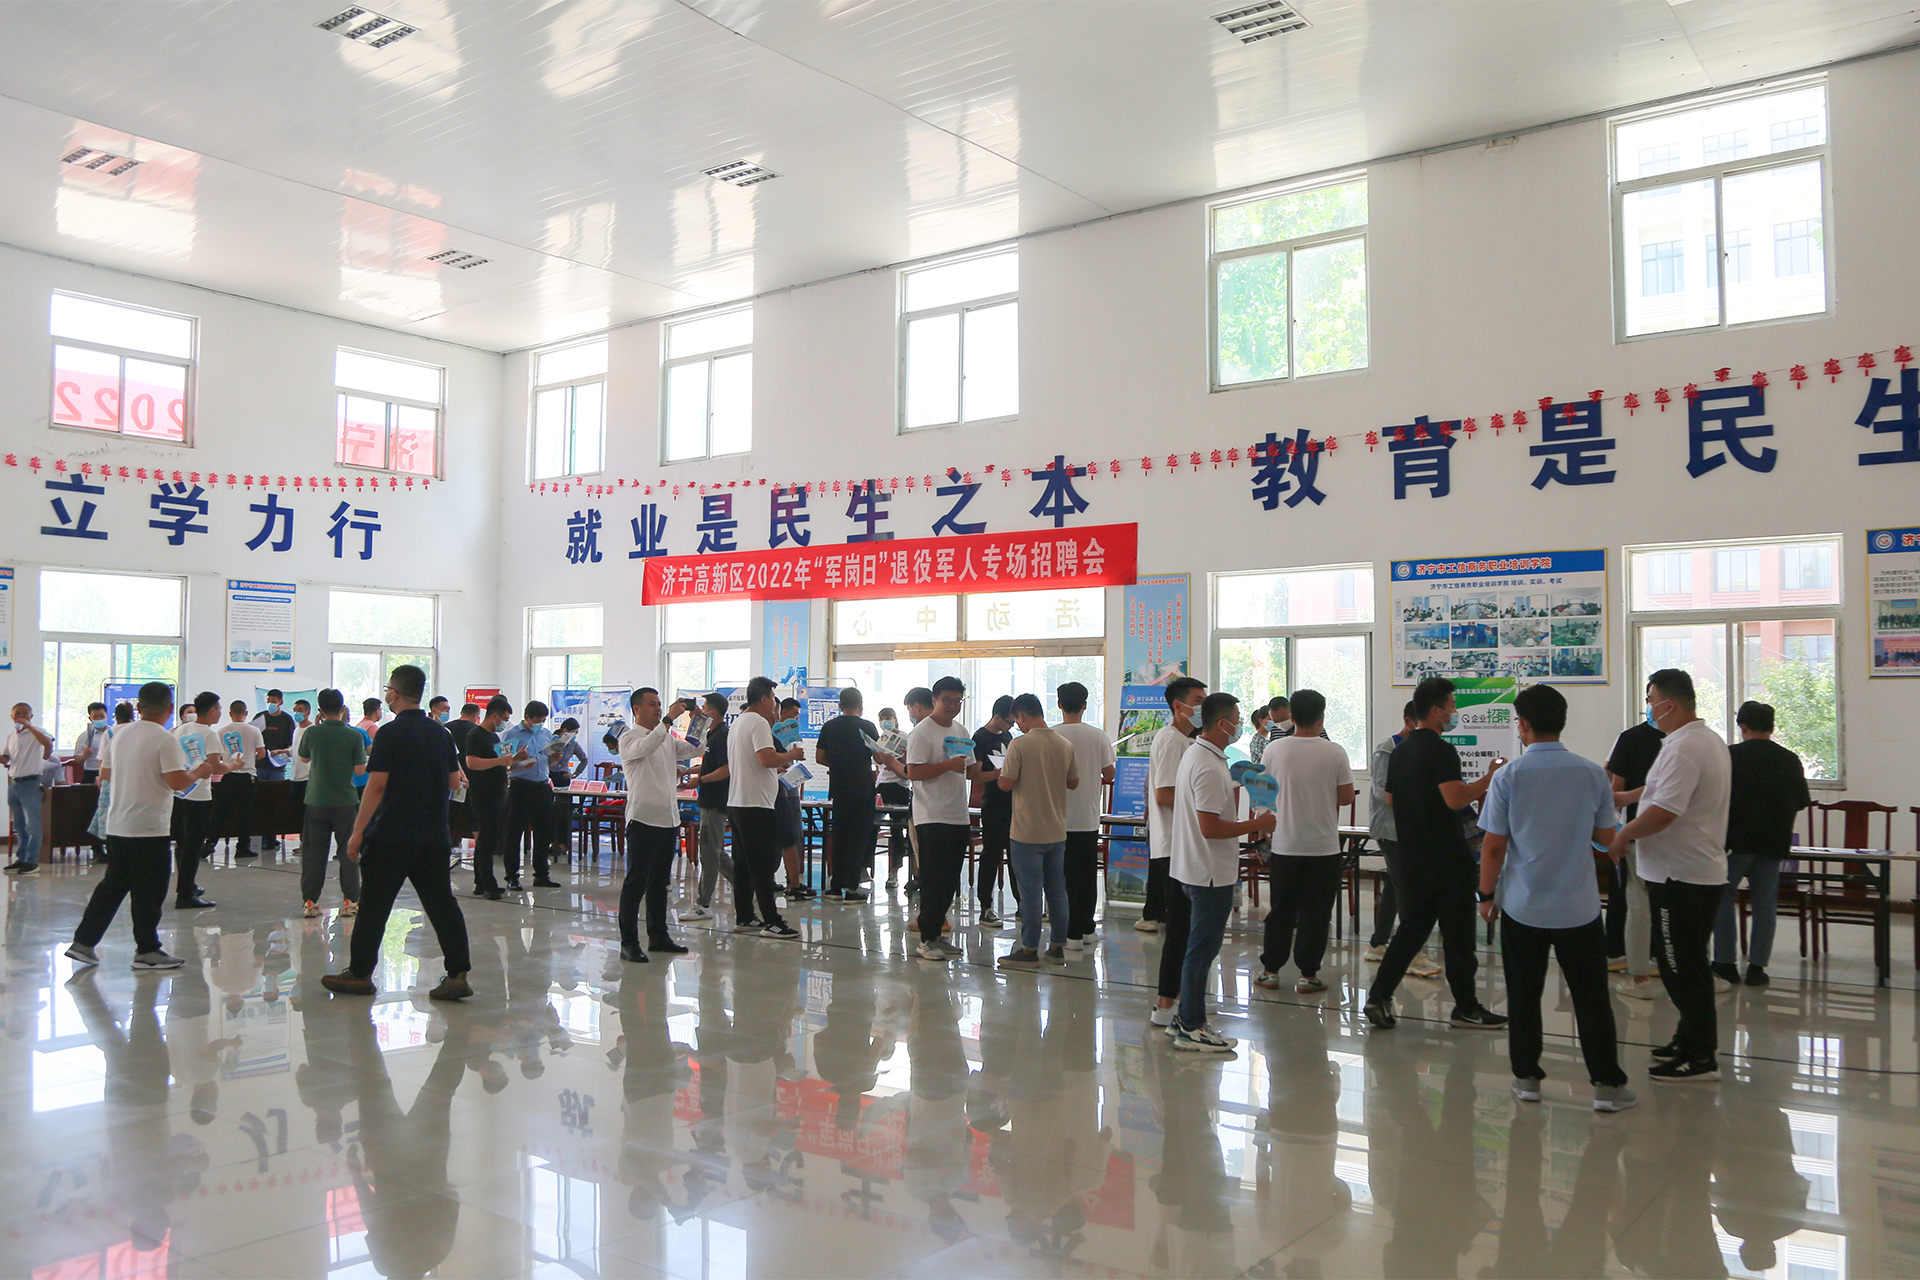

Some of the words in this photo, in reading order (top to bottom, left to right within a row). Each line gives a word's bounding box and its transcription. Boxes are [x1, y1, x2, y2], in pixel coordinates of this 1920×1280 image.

[40, 473, 382, 561] 立学力行
[565, 455, 1090, 564] 就业是民生之本
[1902, 533, 1920, 546] 济
[660, 537, 1106, 596] 济宁高新区2022年“军岗日”退役军人专场招聘会
[1416, 557, 1552, 576] 济宁市工信商务职业培训学院
[1471, 708, 1511, 724] 企业招聘
[1660, 907, 1670, 939] ADVANCE
